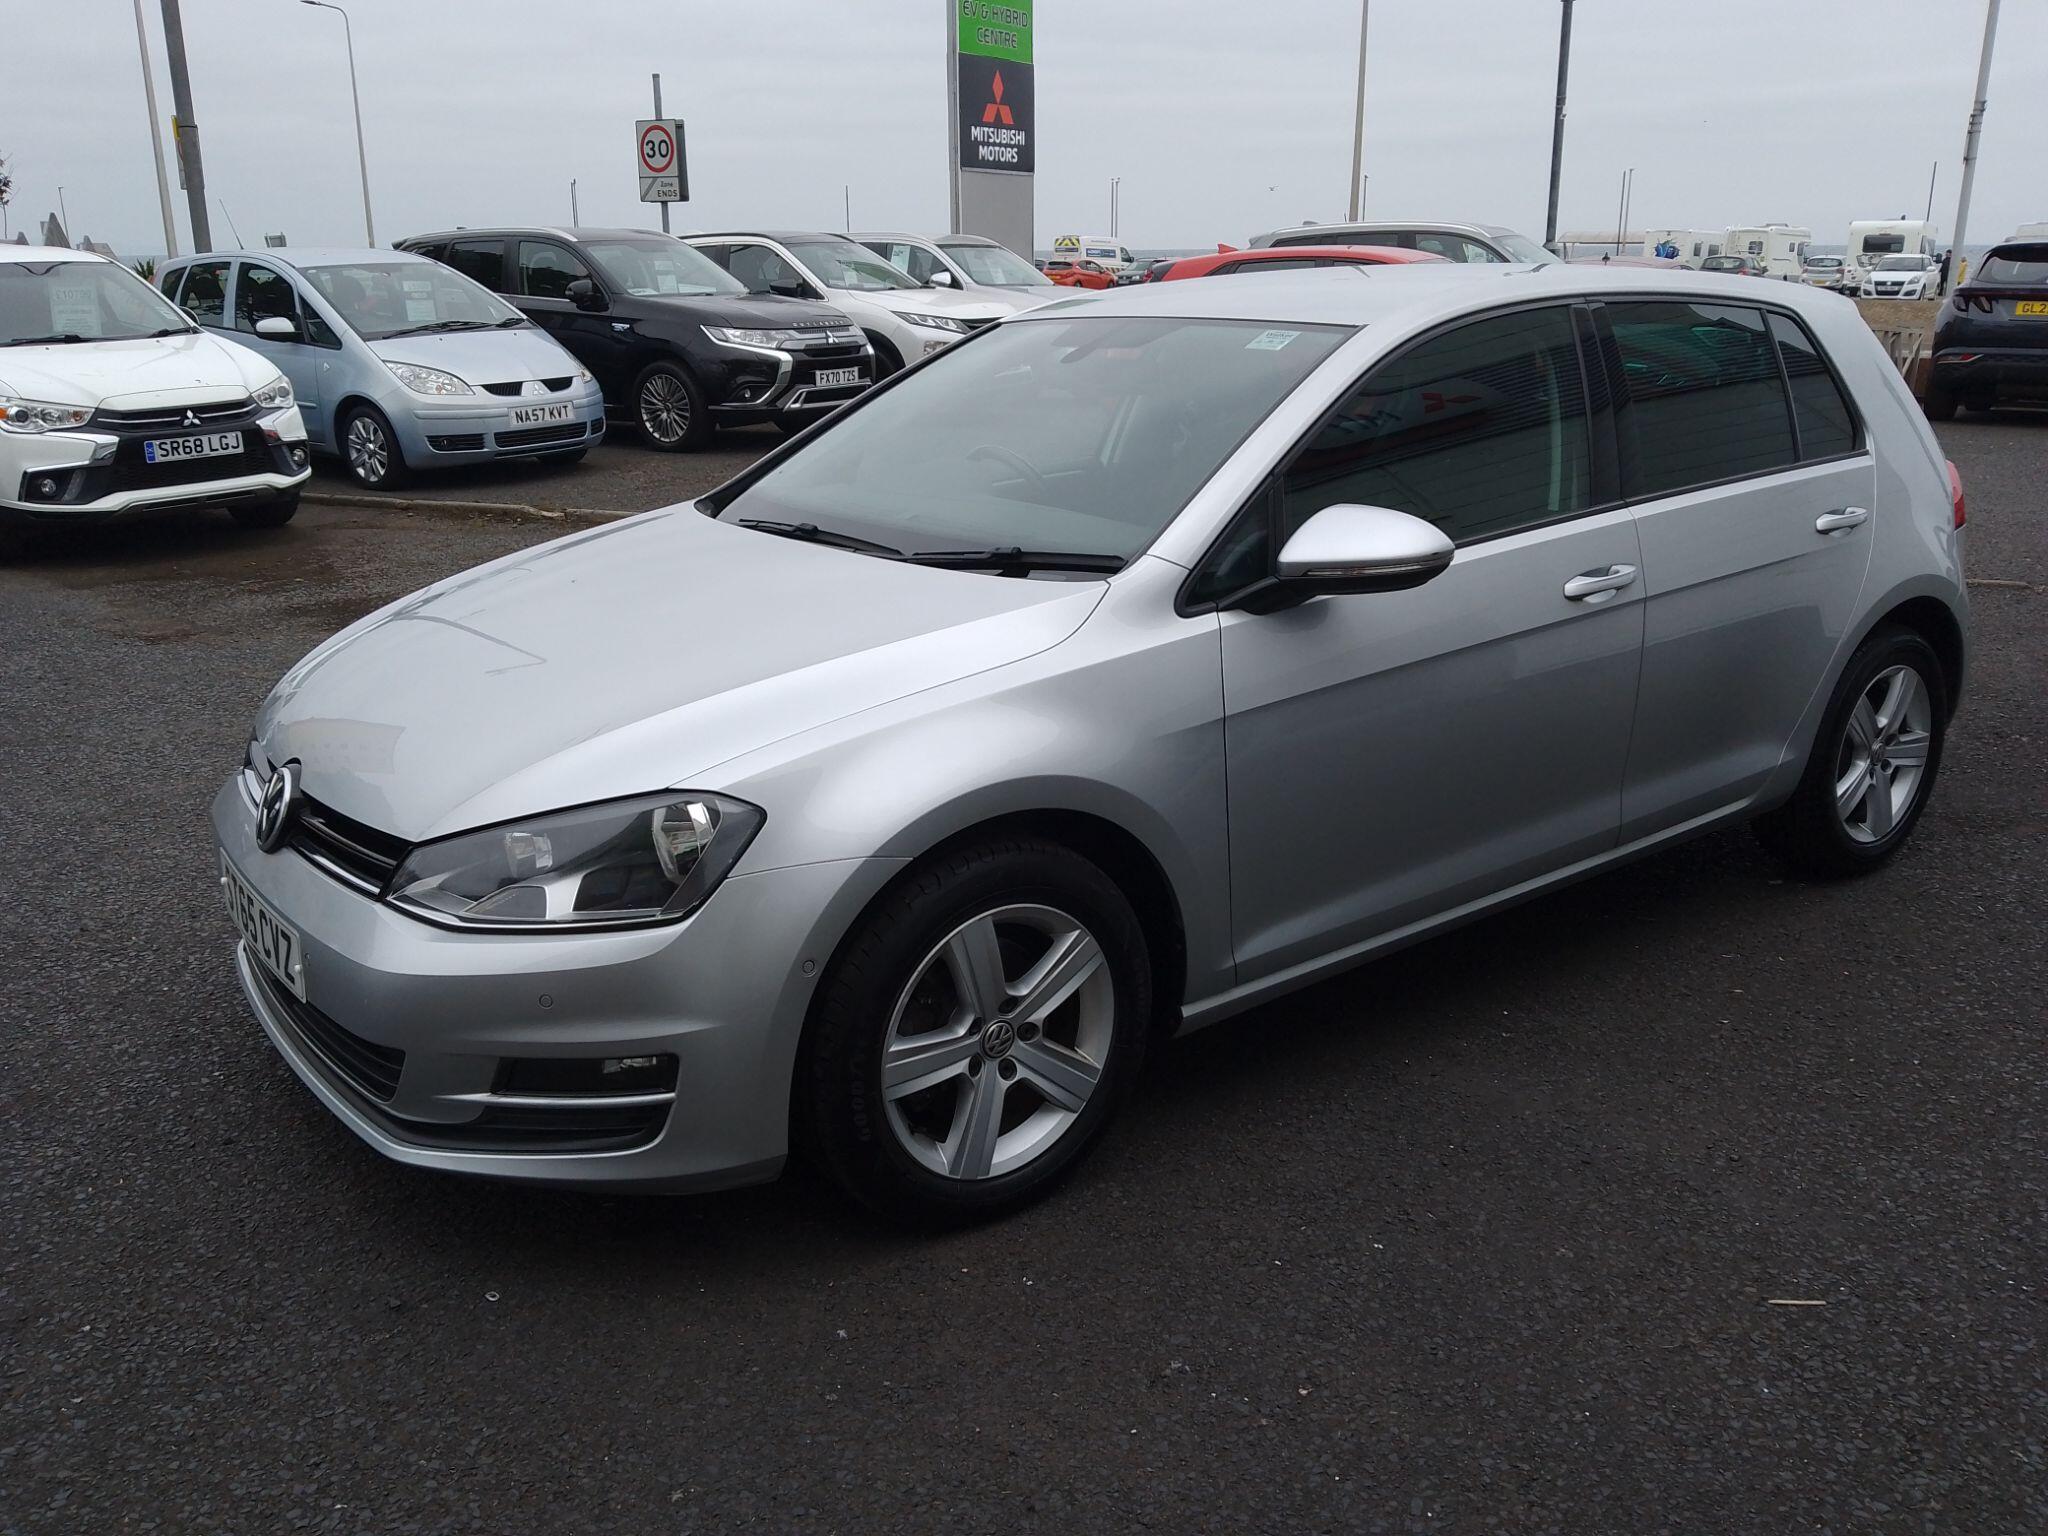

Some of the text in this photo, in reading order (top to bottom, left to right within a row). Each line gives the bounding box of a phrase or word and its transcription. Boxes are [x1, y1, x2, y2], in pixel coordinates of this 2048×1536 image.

[963, 0, 1029, 28] EV & HYBRID
[977, 27, 1017, 49] CENTRE
[971, 125, 1026, 146] MITSUBISHI
[645, 139, 670, 159] 30
[979, 144, 1018, 163] MOTORS
[657, 189, 678, 198] ENDS
[2022, 303, 2048, 314] GL2
[819, 369, 856, 385] FX70 TZS
[515, 405, 569, 424] NA57 KVT
[158, 437, 204, 458] SR68
[208, 433, 240, 453] LGJ
[259, 908, 296, 986] CVZ
